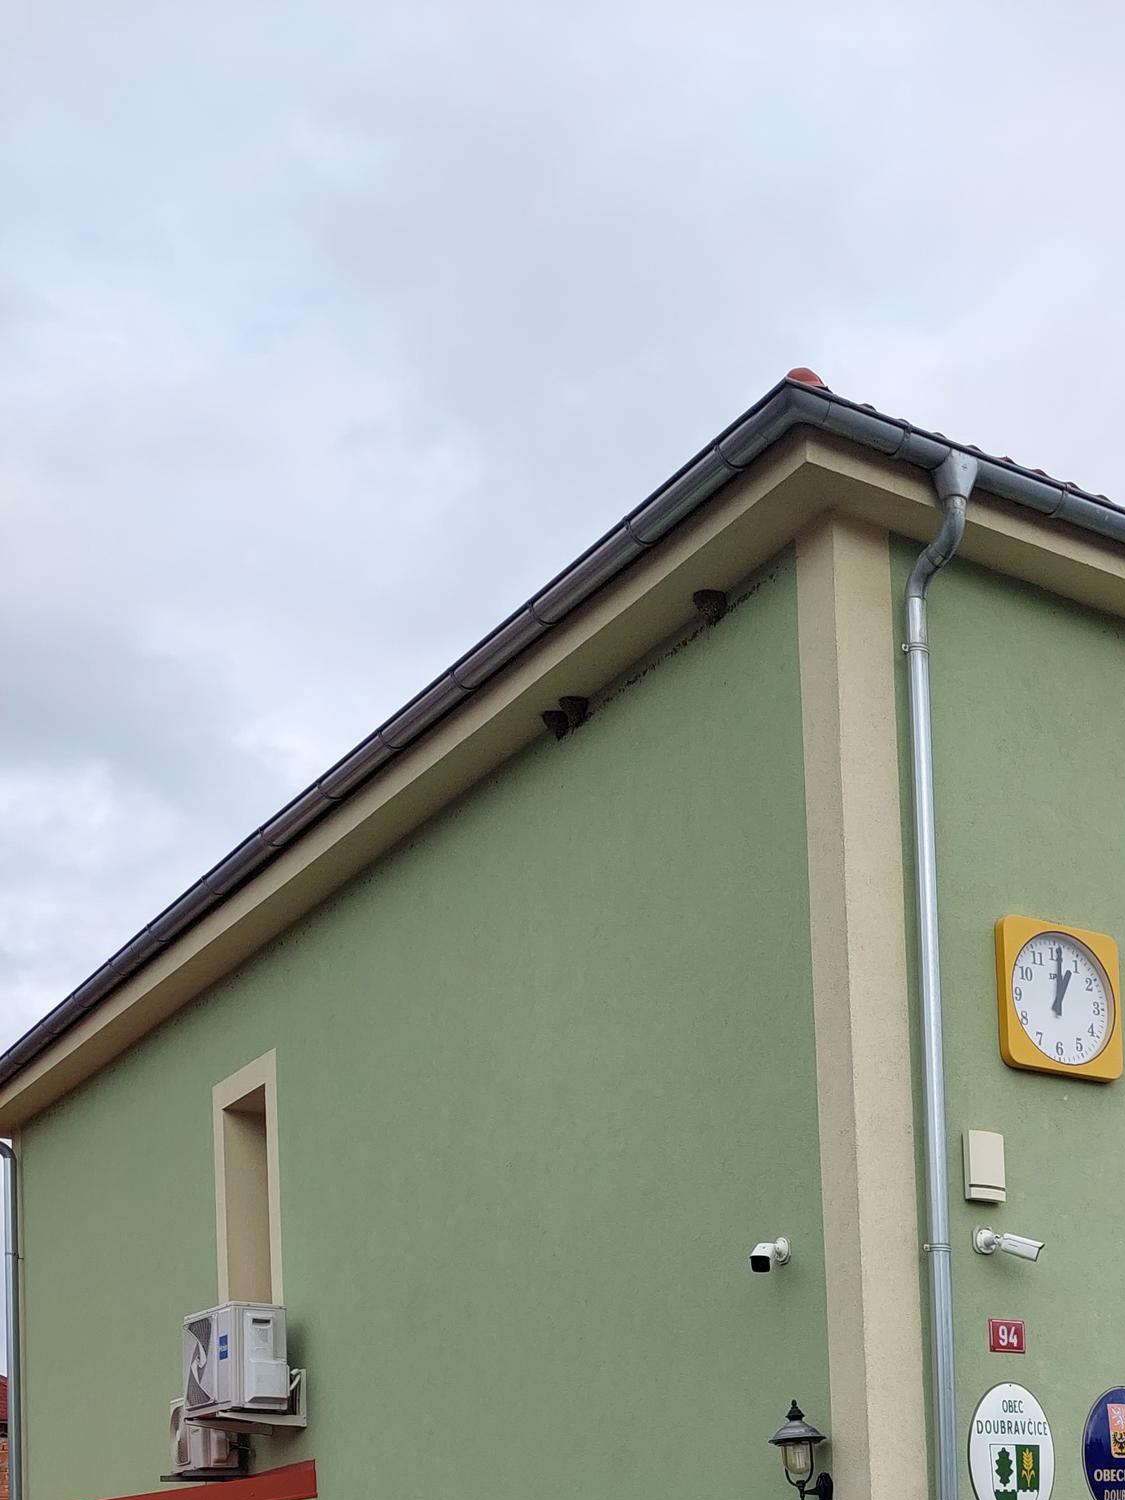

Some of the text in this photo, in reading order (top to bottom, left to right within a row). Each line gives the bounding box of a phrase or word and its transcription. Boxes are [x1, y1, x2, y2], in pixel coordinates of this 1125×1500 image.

[1030, 950, 1045, 966] 11
[1019, 966, 1033, 982] 10
[1072, 960, 1080, 974] 1
[1085, 977, 1093, 992] 2
[1014, 987, 1022, 1001] 9
[1093, 1001, 1100, 1016] 3
[1021, 1011, 1029, 1025] 8
[1088, 1024, 1095, 1037] 4
[1035, 1032, 1044, 1046] 7
[1076, 1038, 1083, 1052] 5
[1056, 1041, 1063, 1056] 6
[999, 1325, 1018, 1347] 94
[1002, 1399, 1023, 1413] OBEC
[976, 1418, 1048, 1436] DOUBRAVČICE
